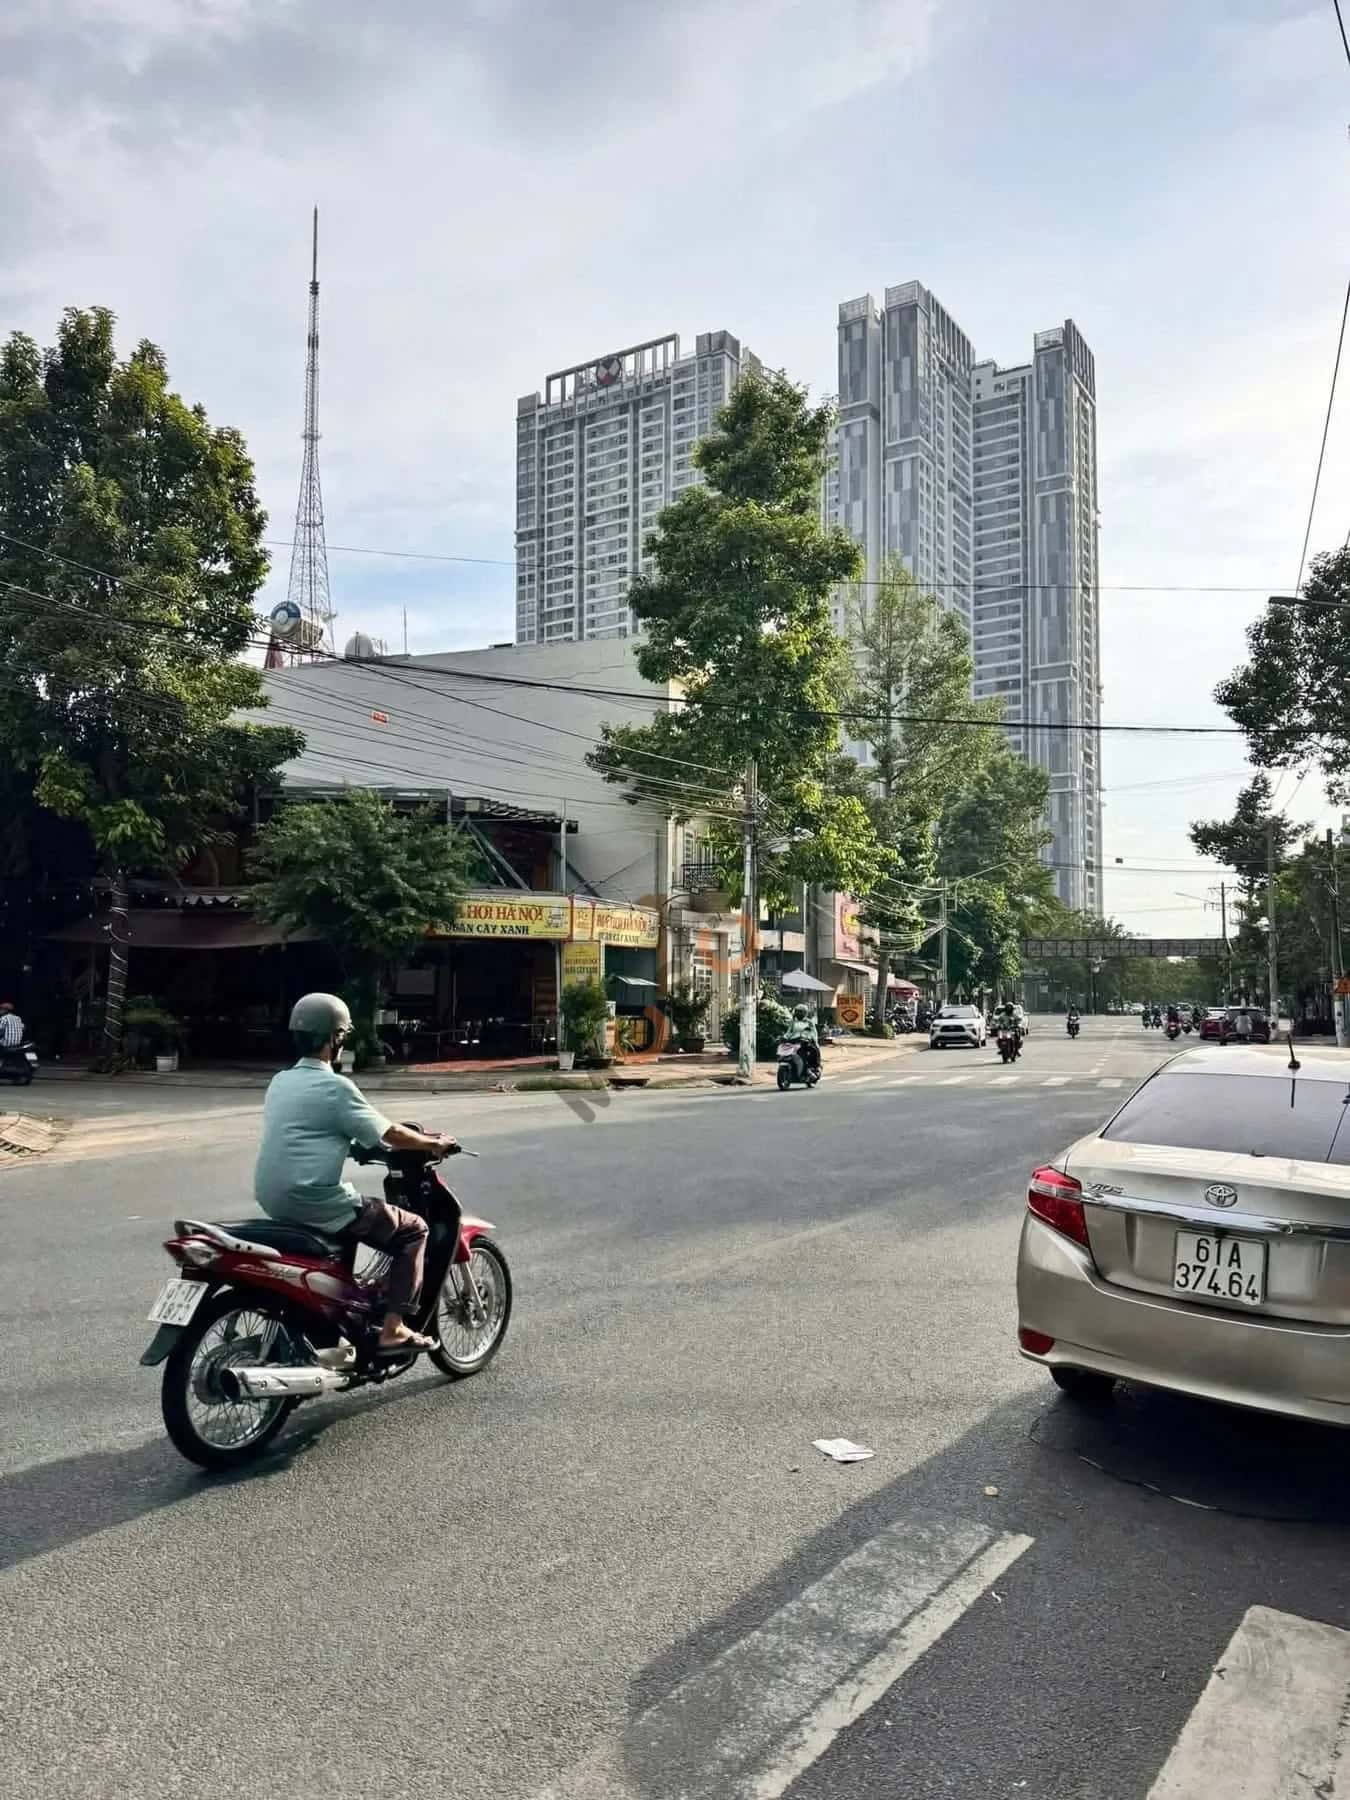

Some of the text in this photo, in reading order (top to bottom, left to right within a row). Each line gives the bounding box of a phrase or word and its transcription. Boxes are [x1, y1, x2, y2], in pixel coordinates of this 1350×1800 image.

[500, 924, 529, 935] XANH
[1196, 1238, 1241, 1269] 61A
[1176, 1263, 1259, 1301] 374.64
